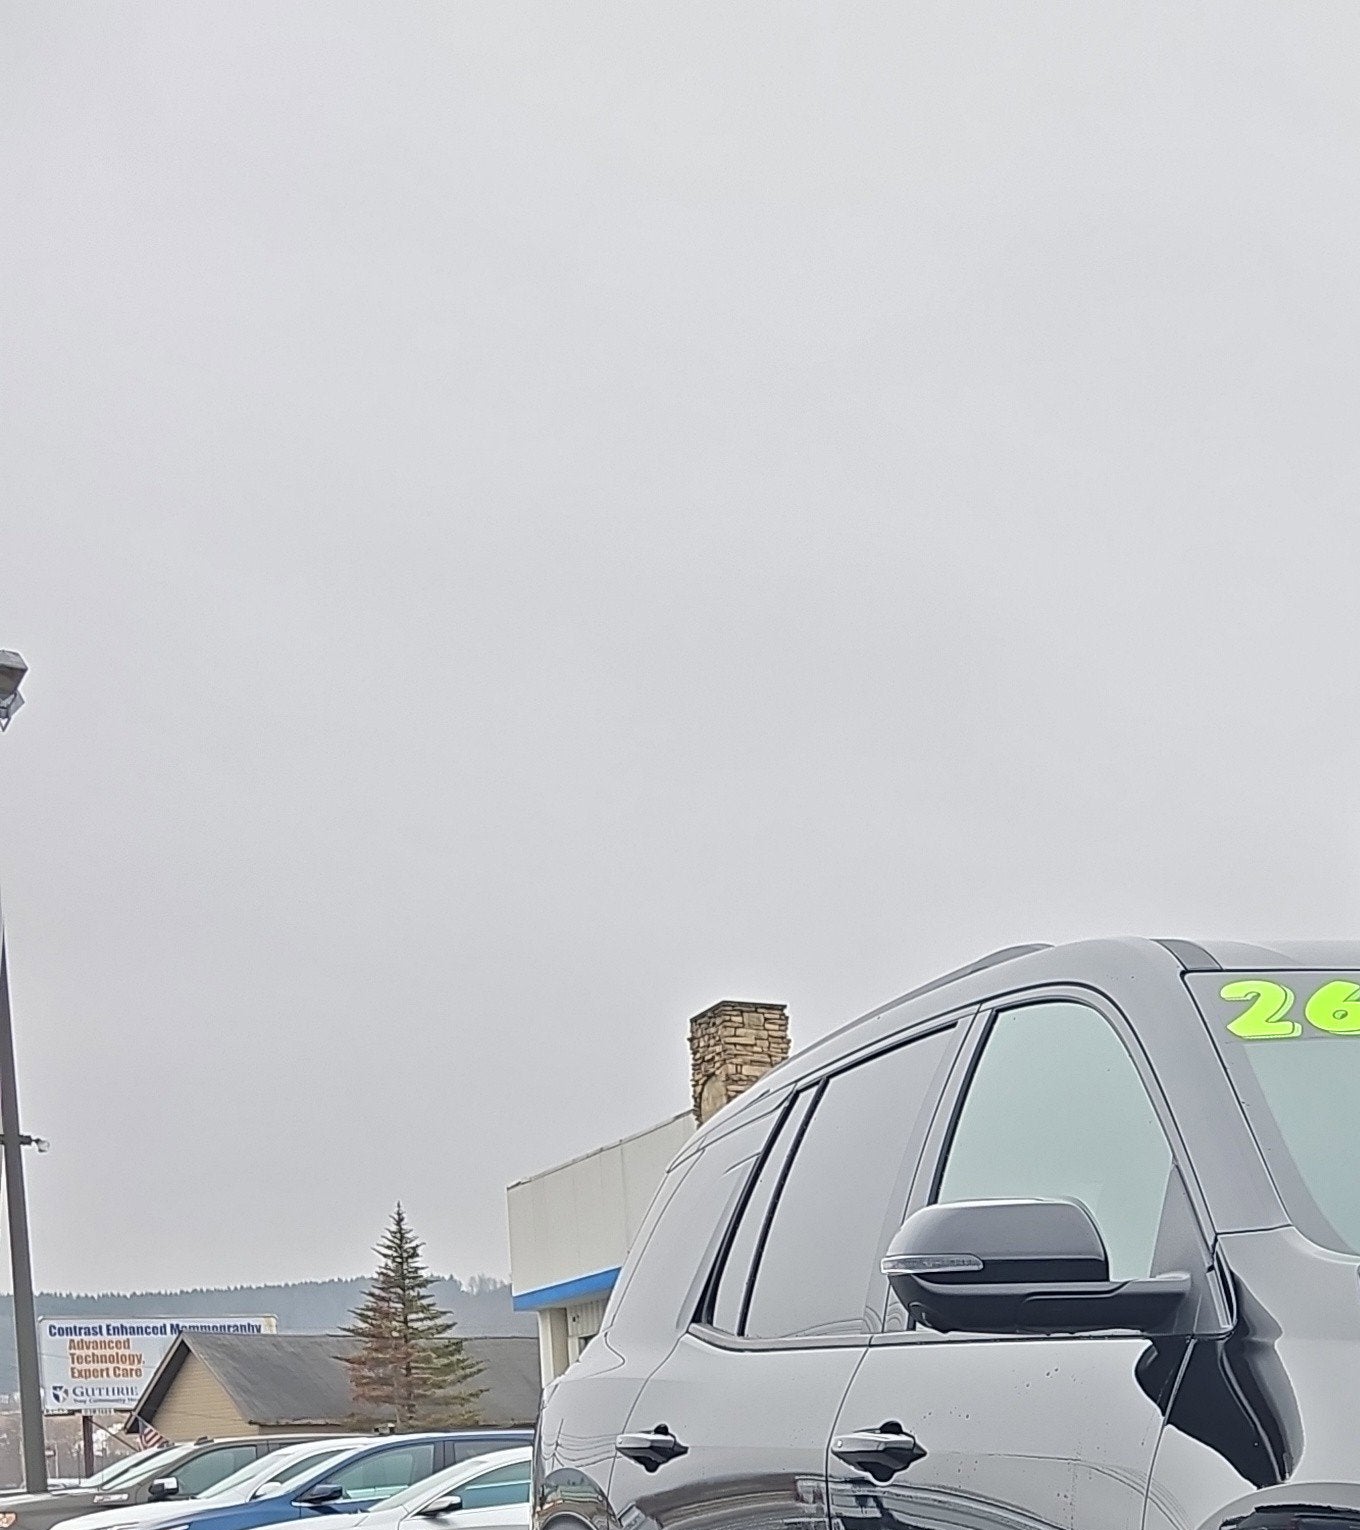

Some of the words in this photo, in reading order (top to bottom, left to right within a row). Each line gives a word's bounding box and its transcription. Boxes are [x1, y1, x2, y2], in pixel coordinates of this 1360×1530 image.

[48, 1325, 105, 1337] Contrast
[106, 1323, 167, 1336] Enhanced
[68, 1338, 131, 1351] Advanced
[70, 1367, 111, 1380] Expert
[112, 1366, 142, 1378] Care
